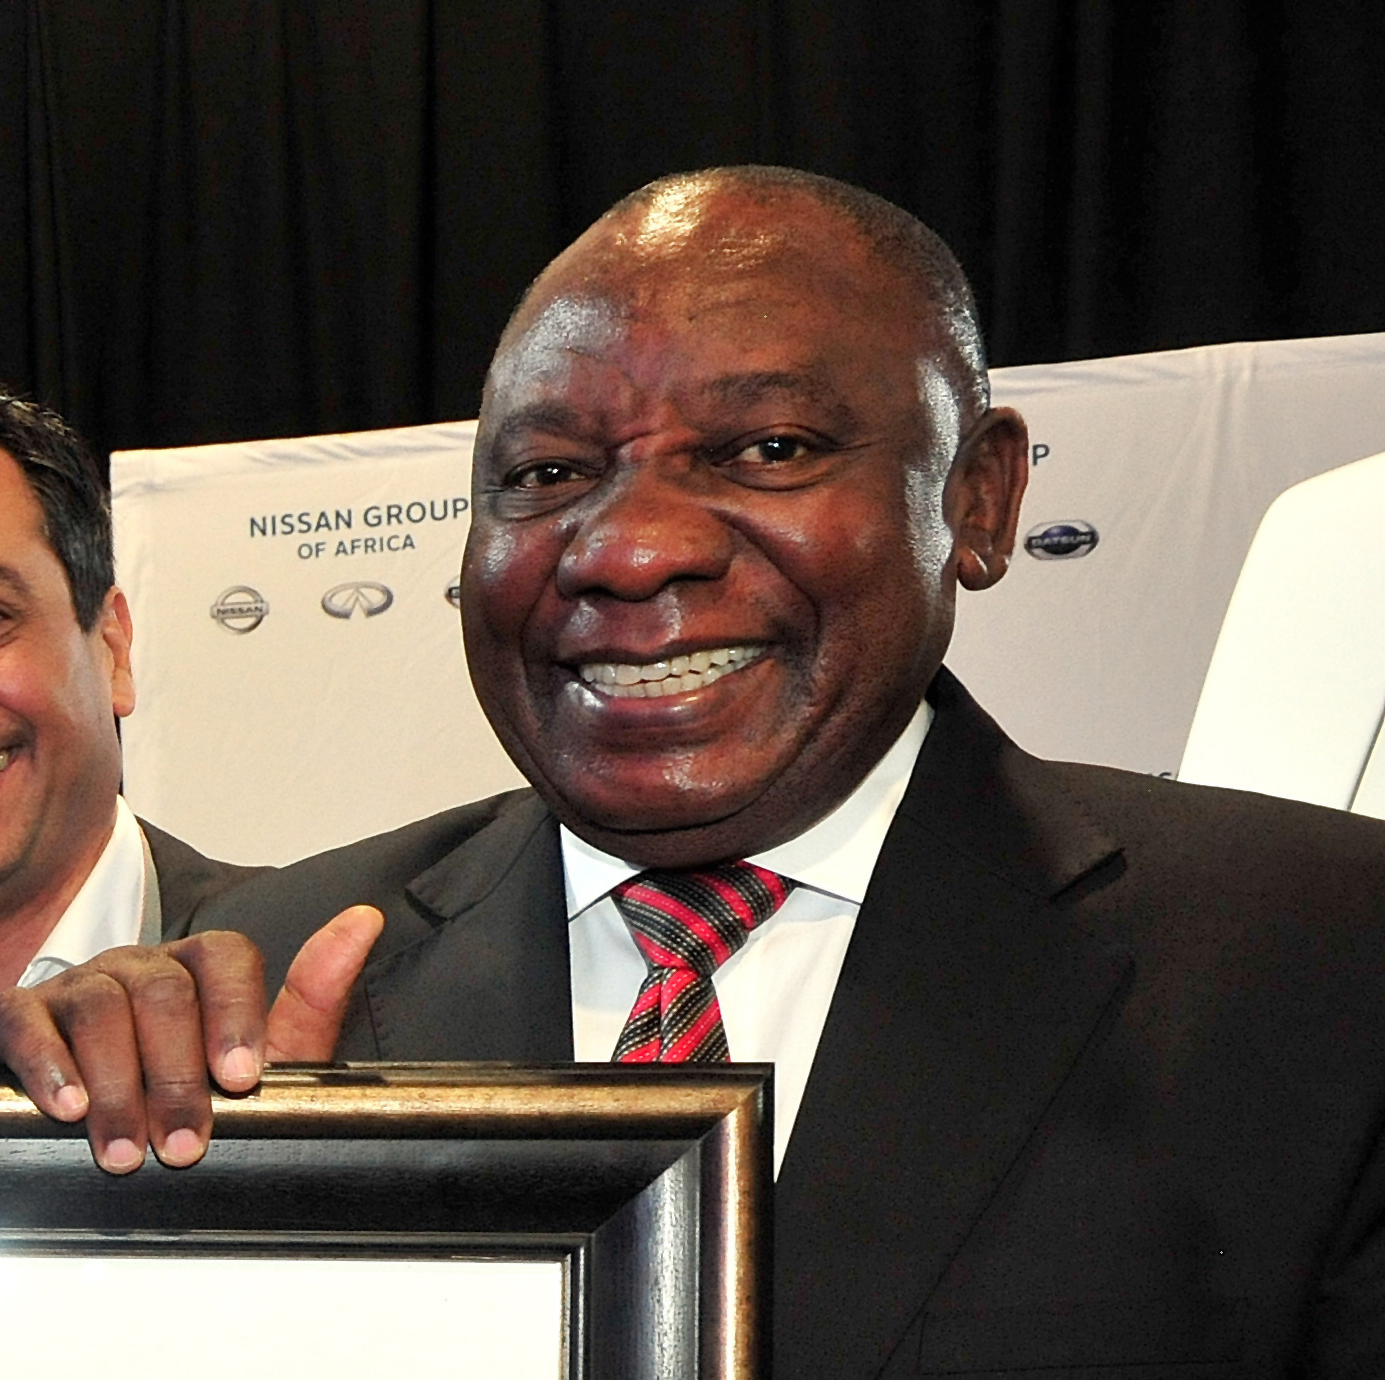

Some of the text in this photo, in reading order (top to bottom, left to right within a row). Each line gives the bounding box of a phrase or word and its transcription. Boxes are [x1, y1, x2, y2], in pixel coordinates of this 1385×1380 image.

[249, 497, 470, 538] NISSAN GROUP
[297, 533, 417, 560] OF AFRICA
